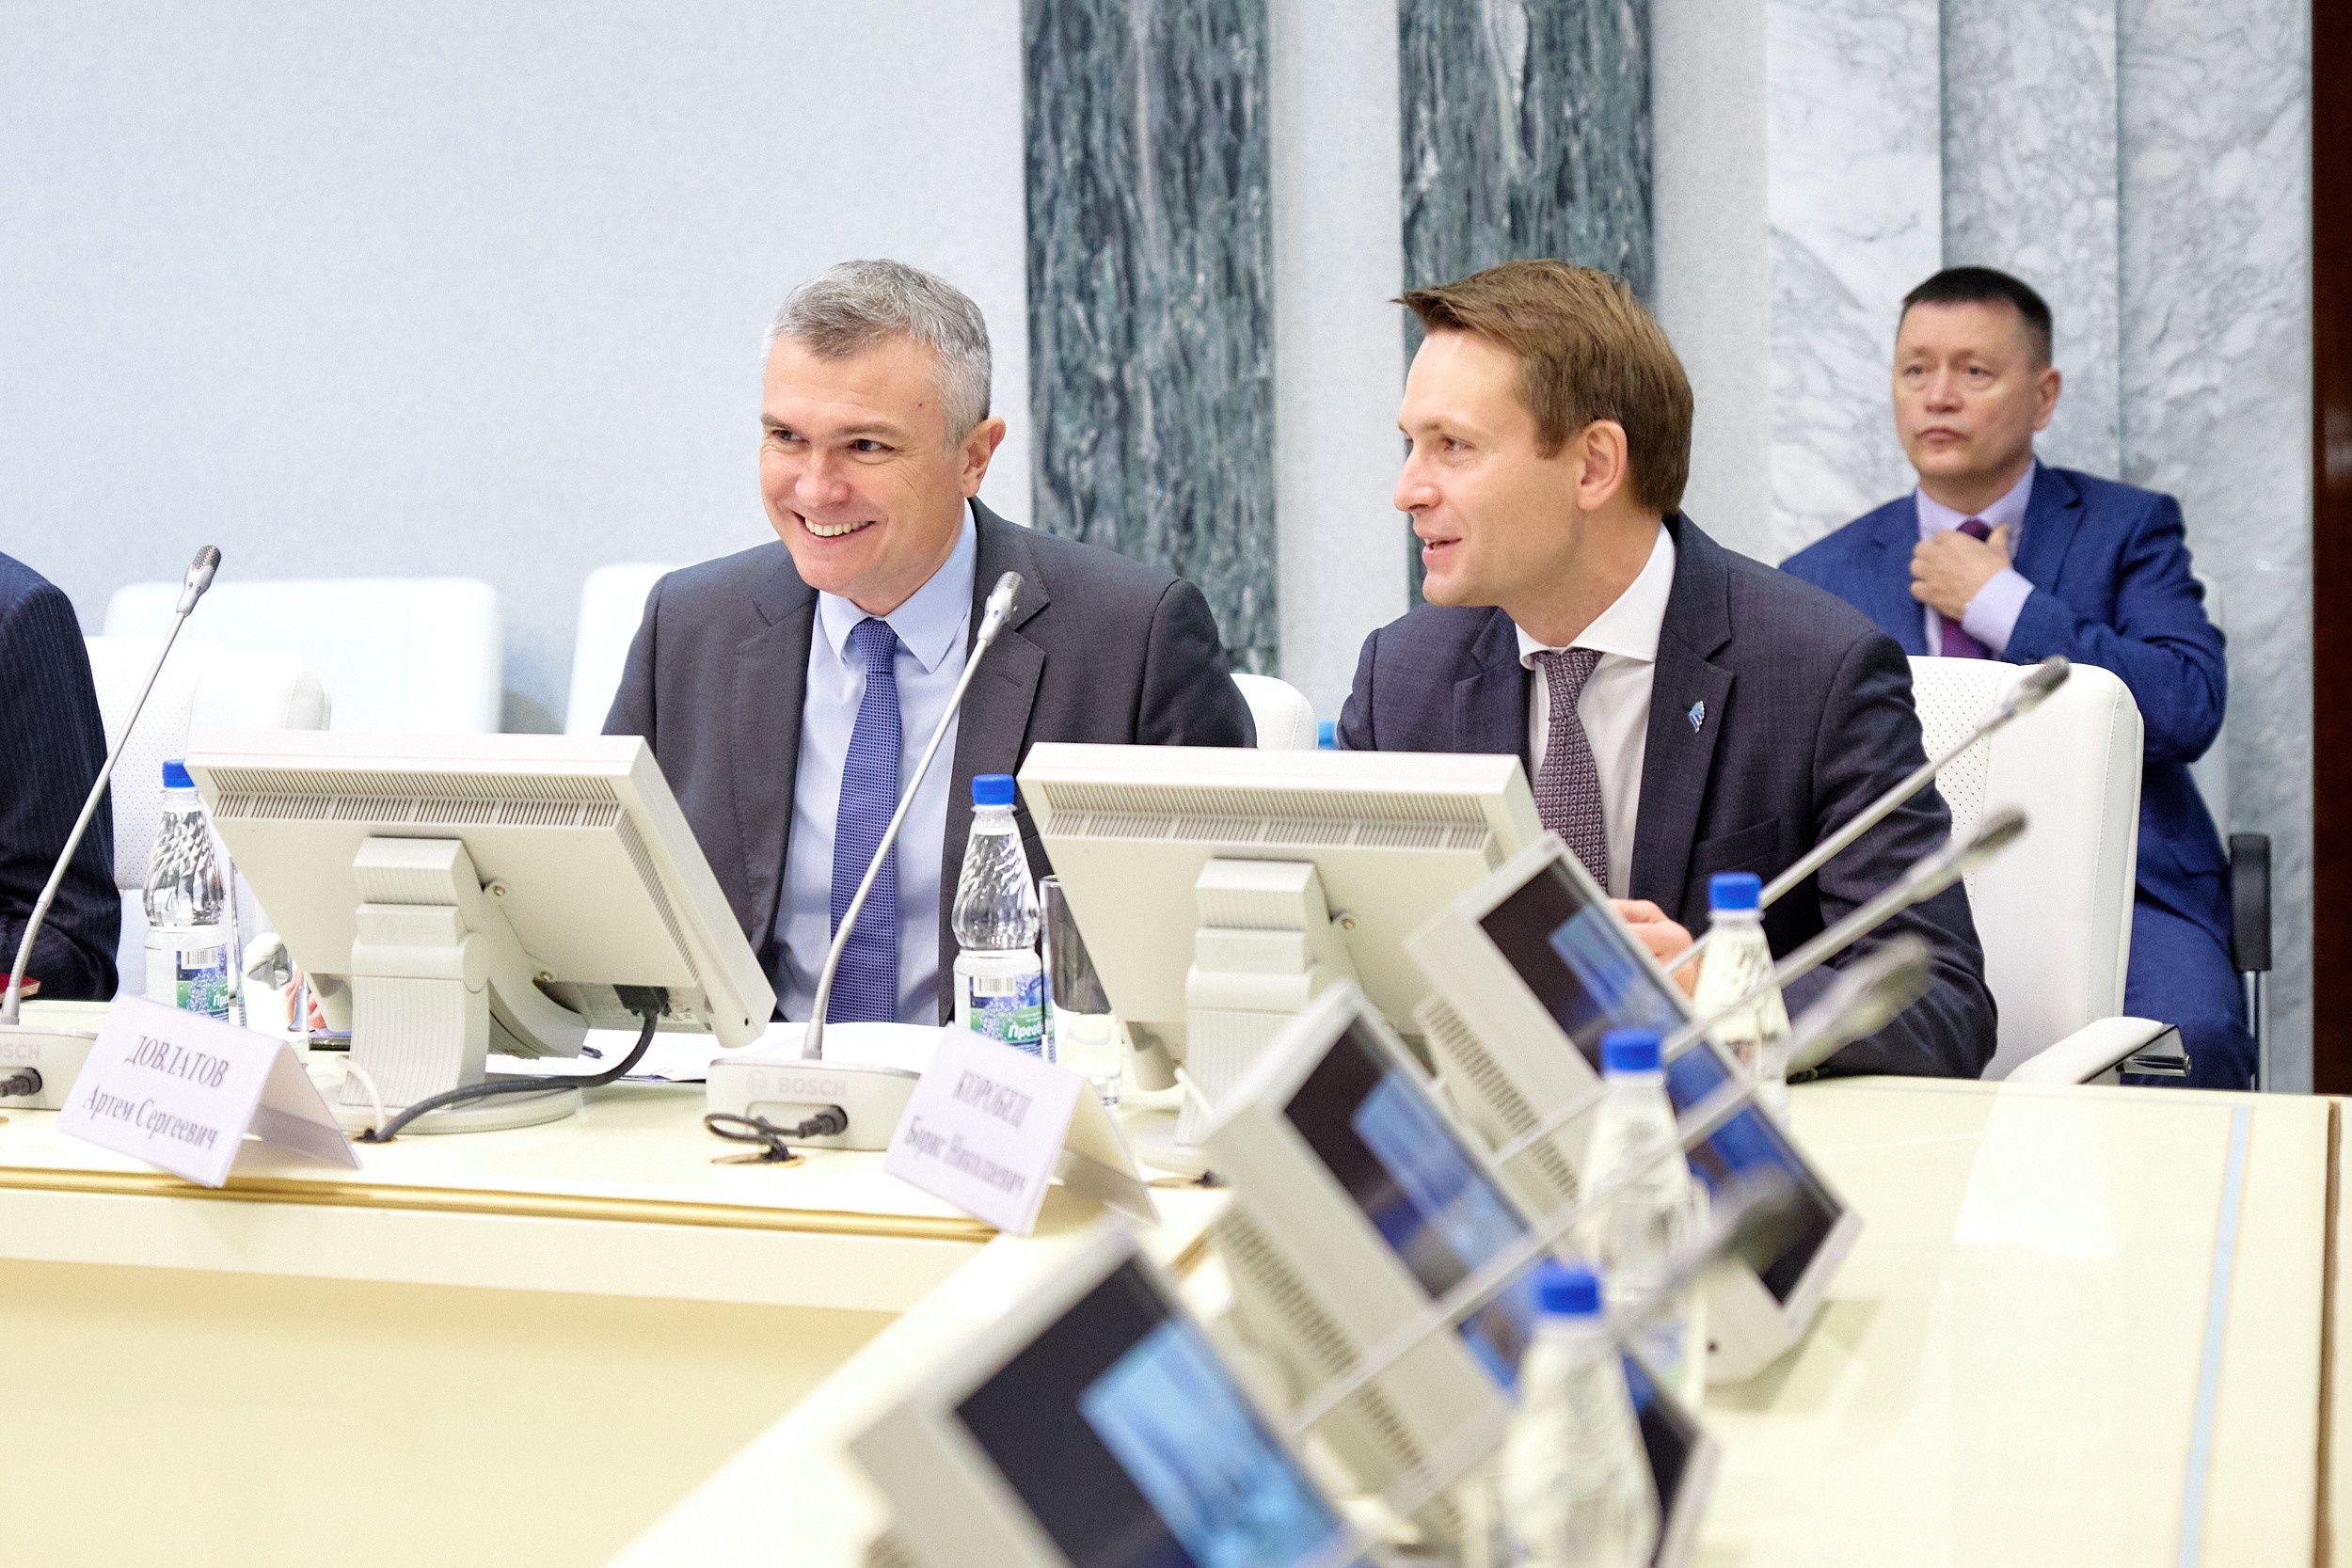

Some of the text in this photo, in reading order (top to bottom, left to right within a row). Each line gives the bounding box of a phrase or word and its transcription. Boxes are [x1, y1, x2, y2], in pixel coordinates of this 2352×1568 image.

[0, 1043, 40, 1060] SCH
[123, 1035, 230, 1088] ДОВЛАТОВ
[778, 1076, 847, 1096] BOSCH
[83, 1082, 218, 1150] Артем Сергеевич
